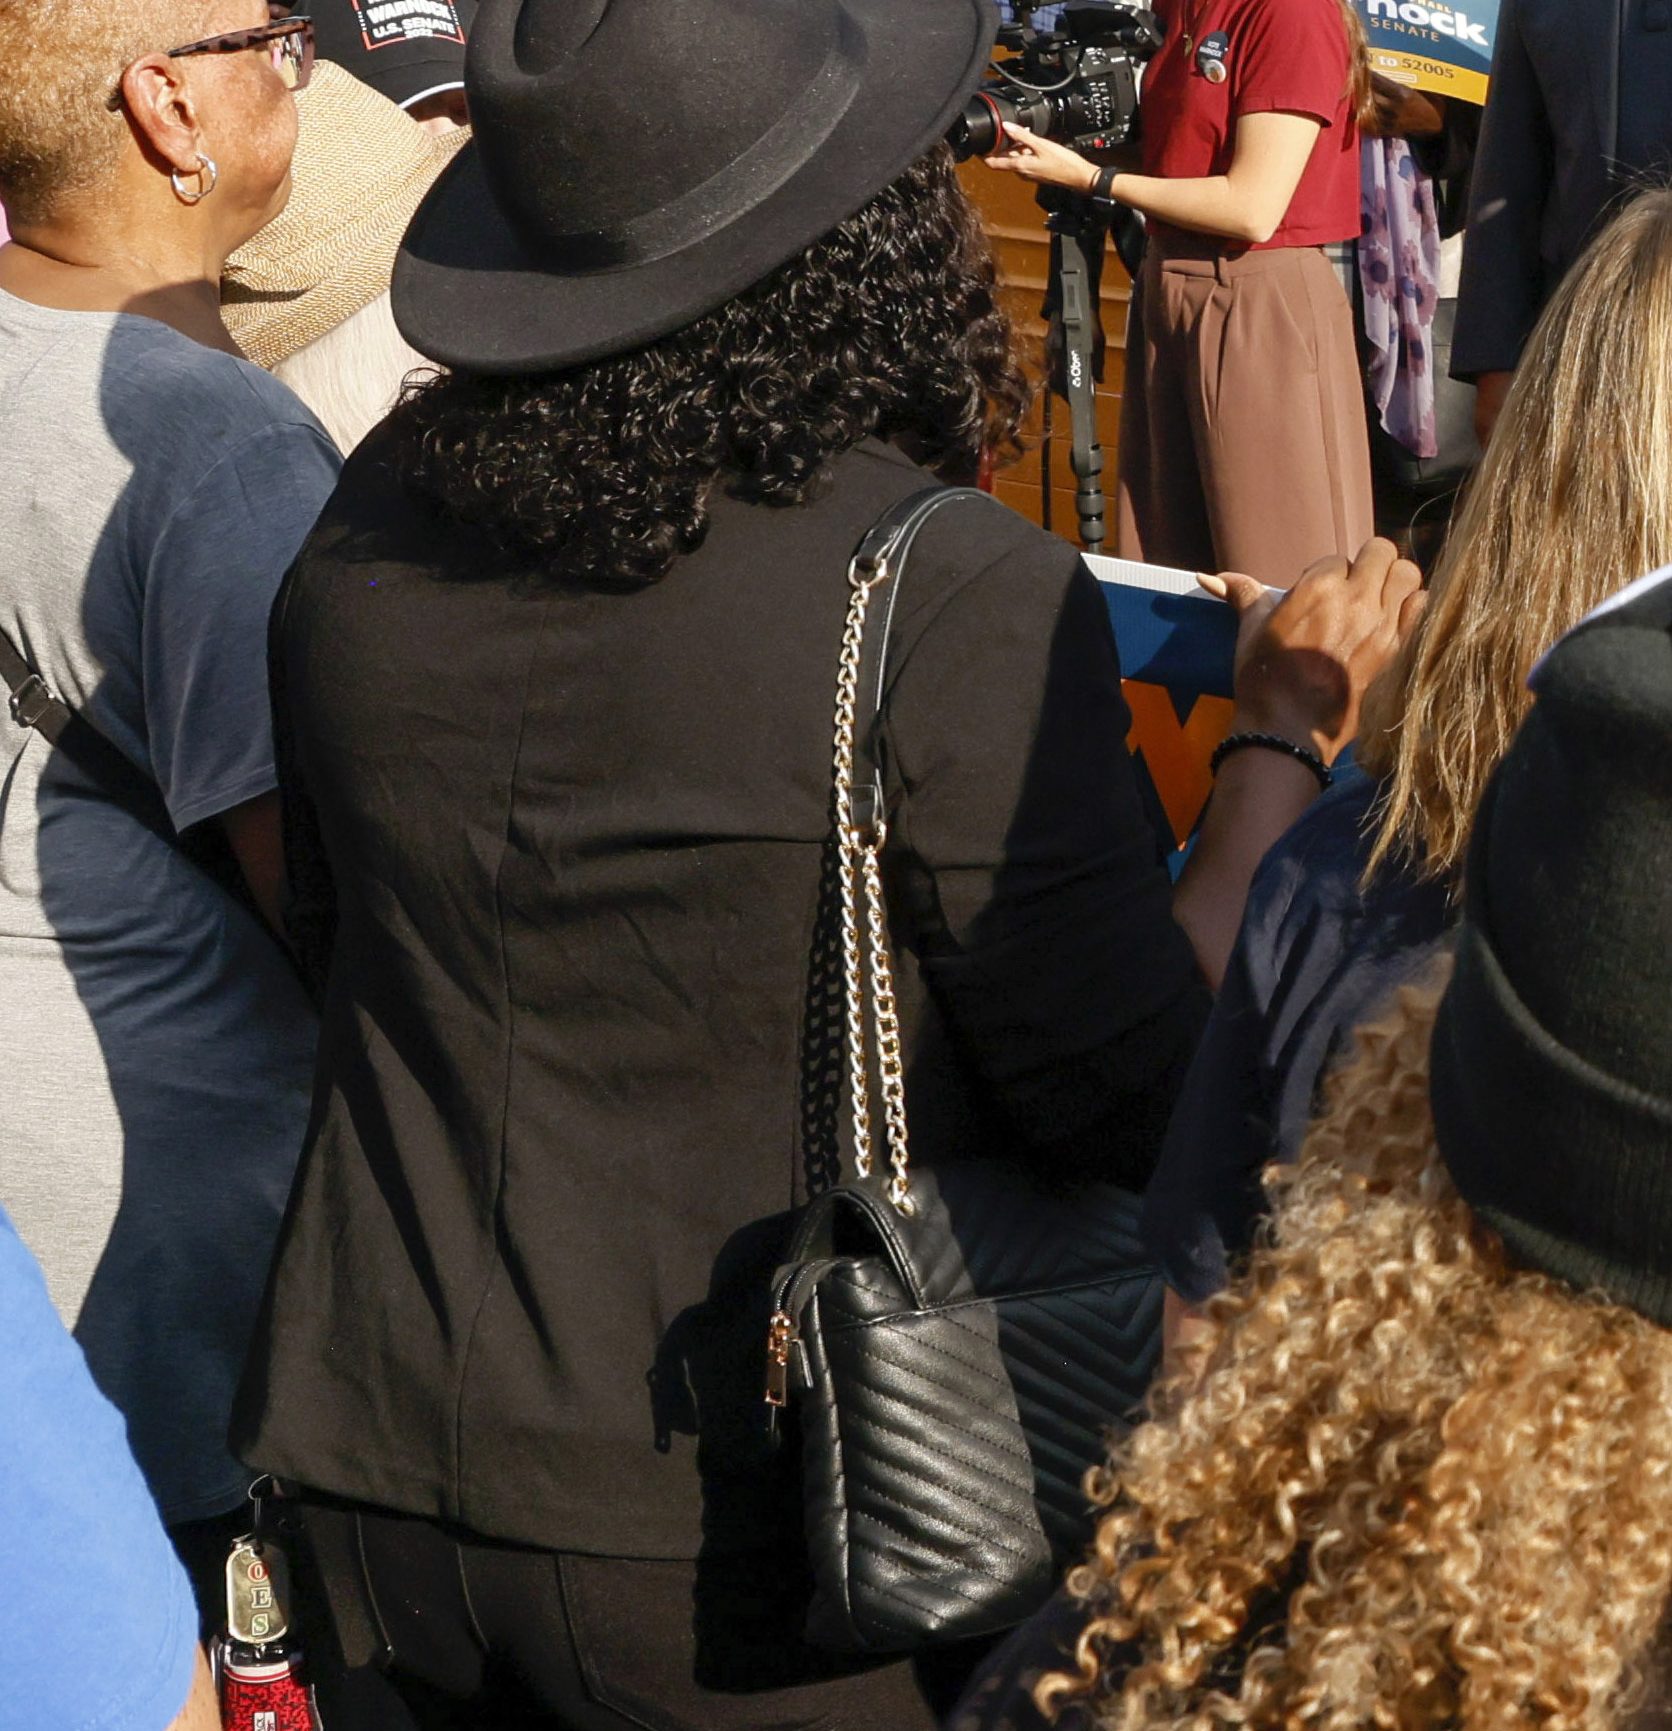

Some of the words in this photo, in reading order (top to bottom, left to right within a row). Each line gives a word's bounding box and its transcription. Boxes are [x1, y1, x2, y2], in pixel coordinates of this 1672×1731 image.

[401, 17, 456, 34] SENATE
[404, 28, 434, 39] 2022
[1370, 17, 1440, 42] SENATE
[1378, 54, 1398, 67] to
[1402, 58, 1455, 79] 52005
